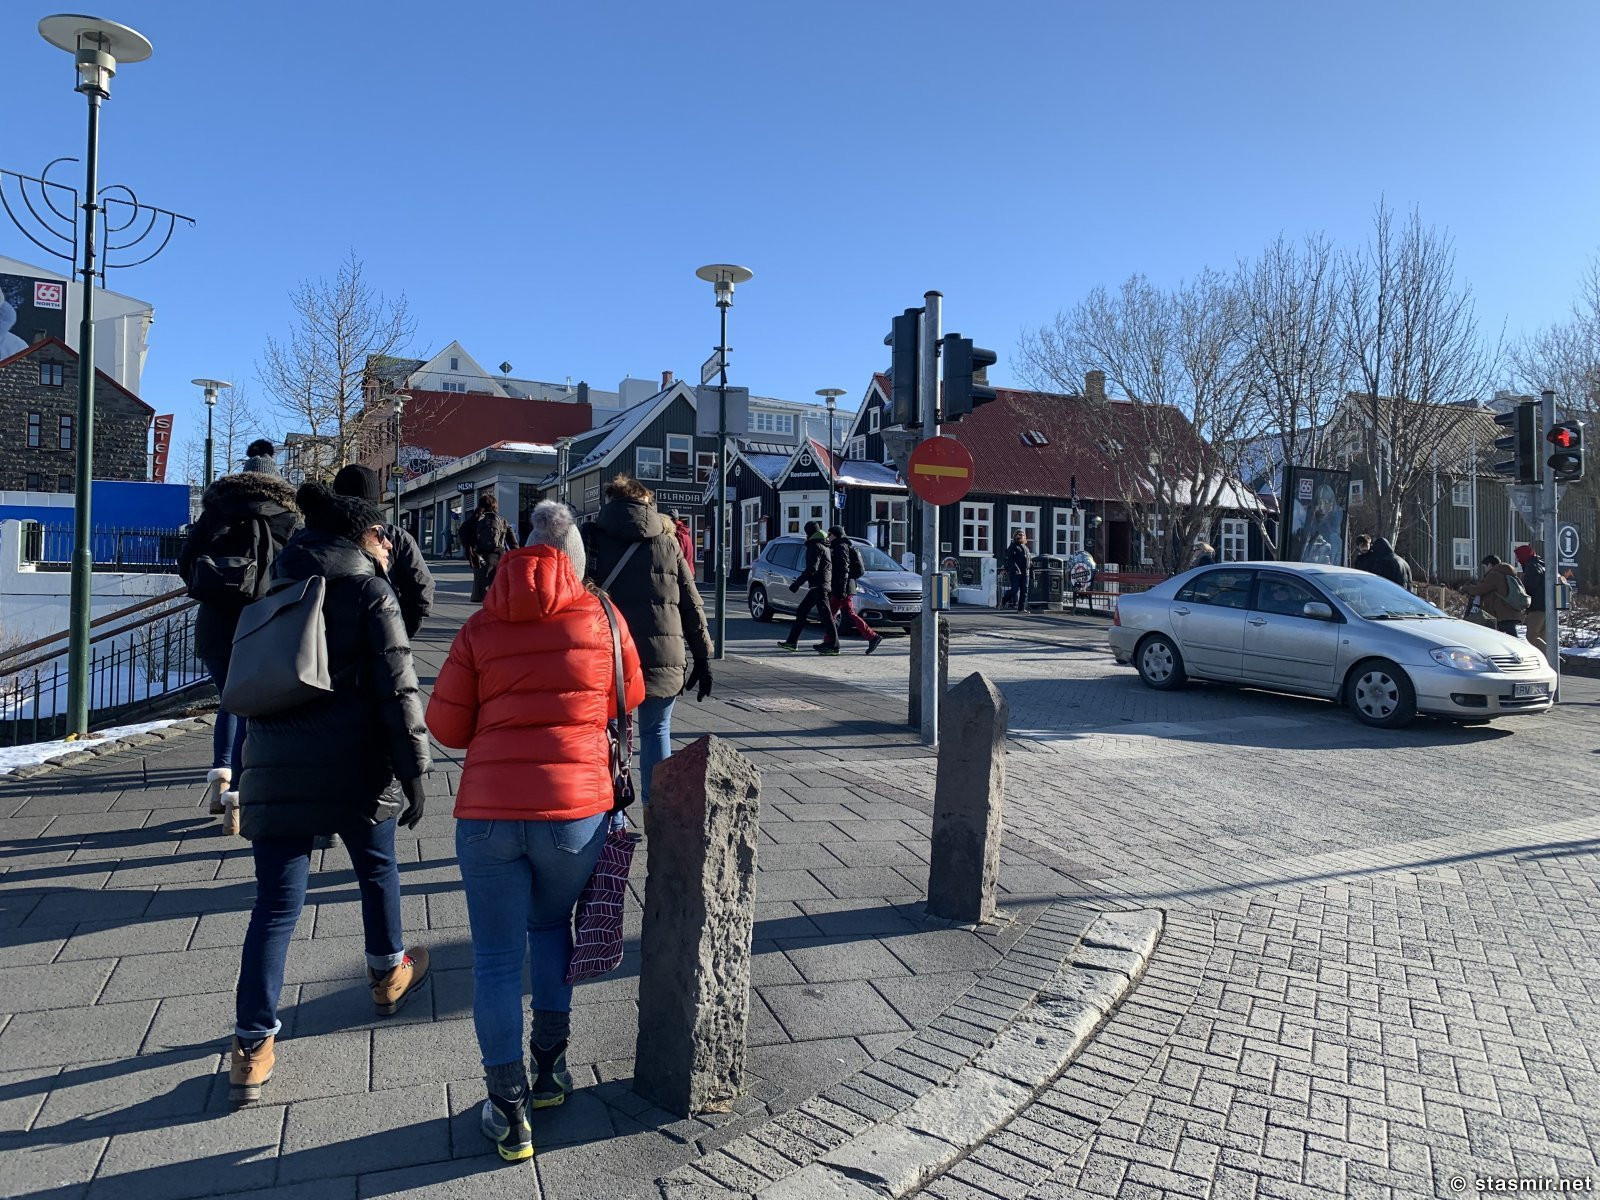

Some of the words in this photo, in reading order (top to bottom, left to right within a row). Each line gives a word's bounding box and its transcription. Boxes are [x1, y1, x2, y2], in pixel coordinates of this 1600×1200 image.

[790, 471, 820, 479] Restaurant
[458, 482, 473, 491] NLSN
[659, 492, 700, 502] ISLANDIA
